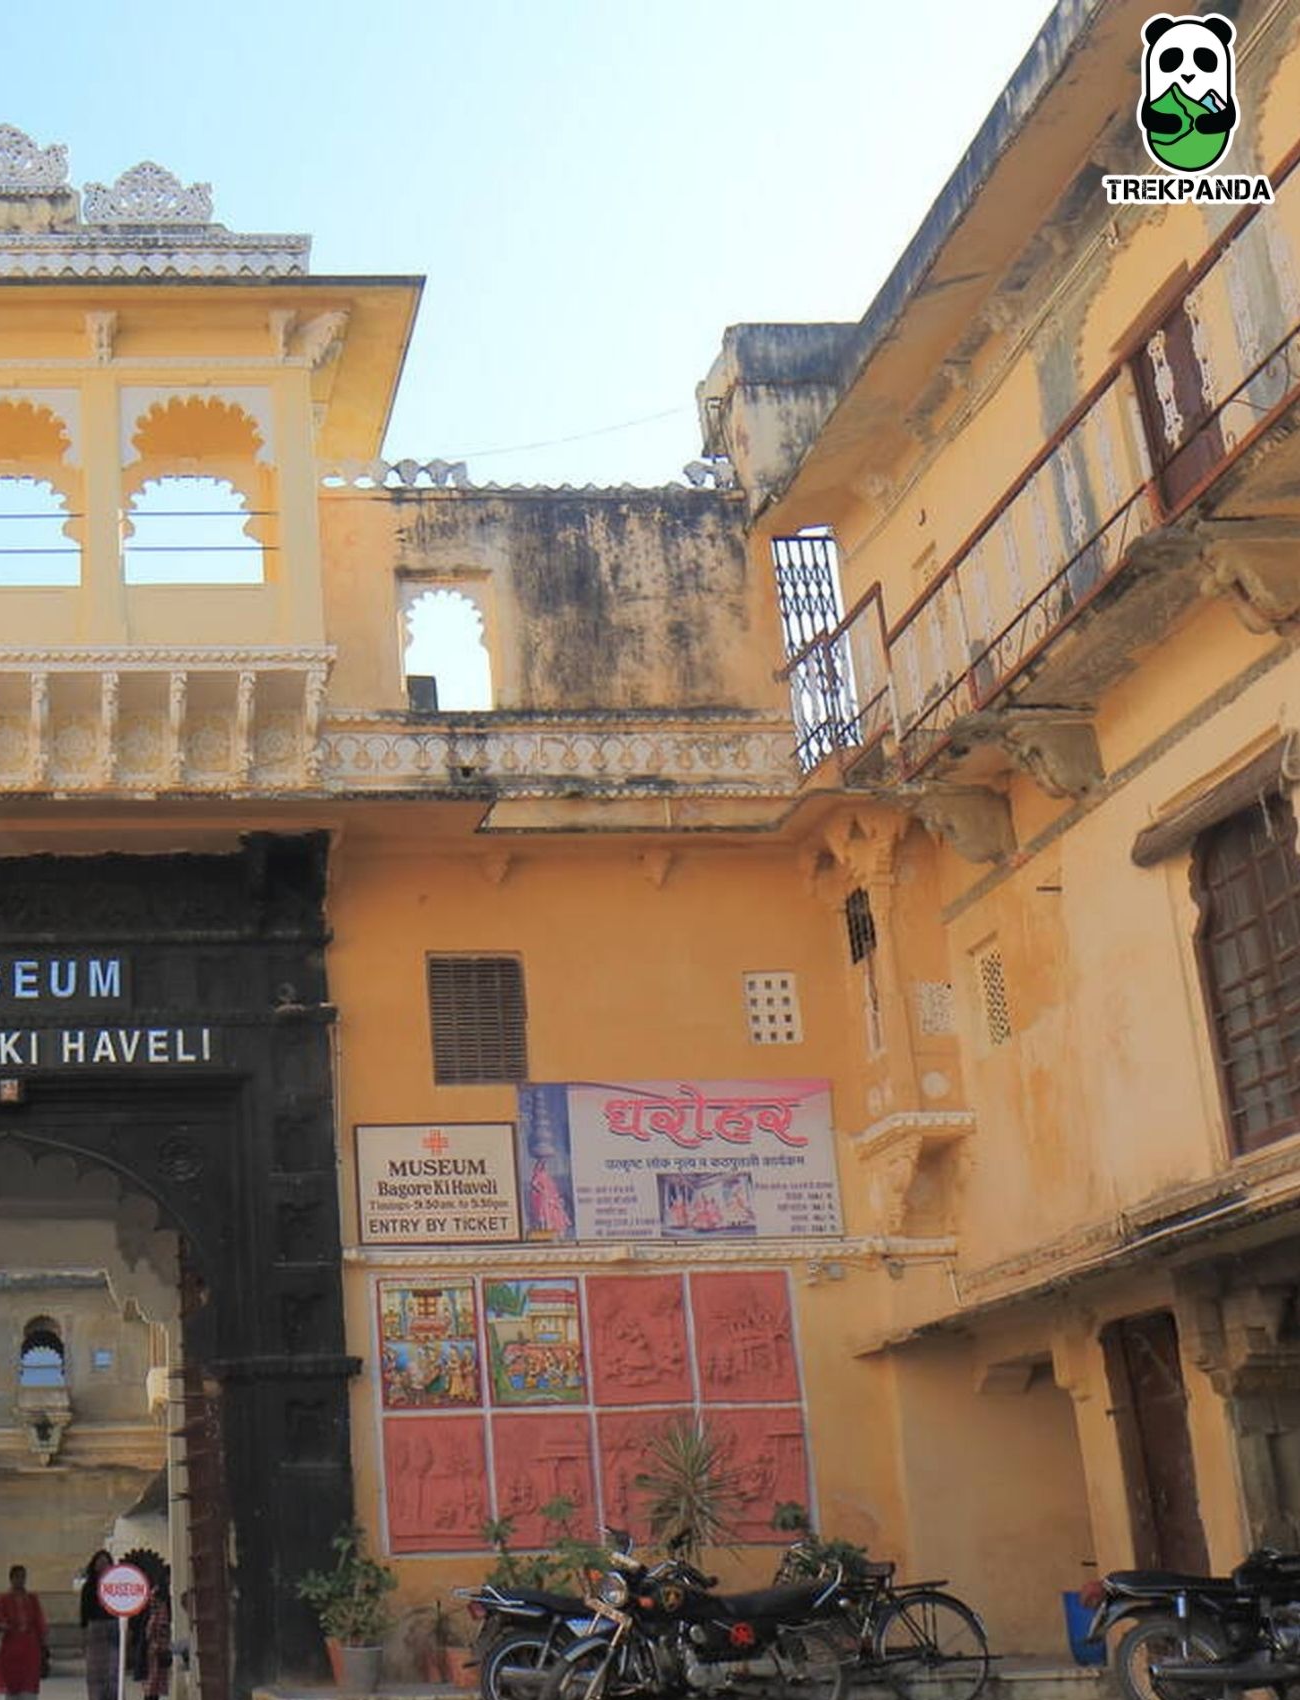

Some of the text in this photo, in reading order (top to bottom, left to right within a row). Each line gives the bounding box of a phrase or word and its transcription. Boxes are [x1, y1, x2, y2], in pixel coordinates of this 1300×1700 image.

[0, 1031, 39, 1066] KI
[62, 1028, 213, 1063] HAVELI
[604, 1082, 810, 1149] धरोहर
[388, 1158, 487, 1177] MUSEUM
[378, 1180, 432, 1198] Bagore
[452, 1179, 498, 1195] Haveli
[369, 1216, 509, 1233] ENTRY BY TICKET
[101, 1583, 147, 1597] MUSEUM
